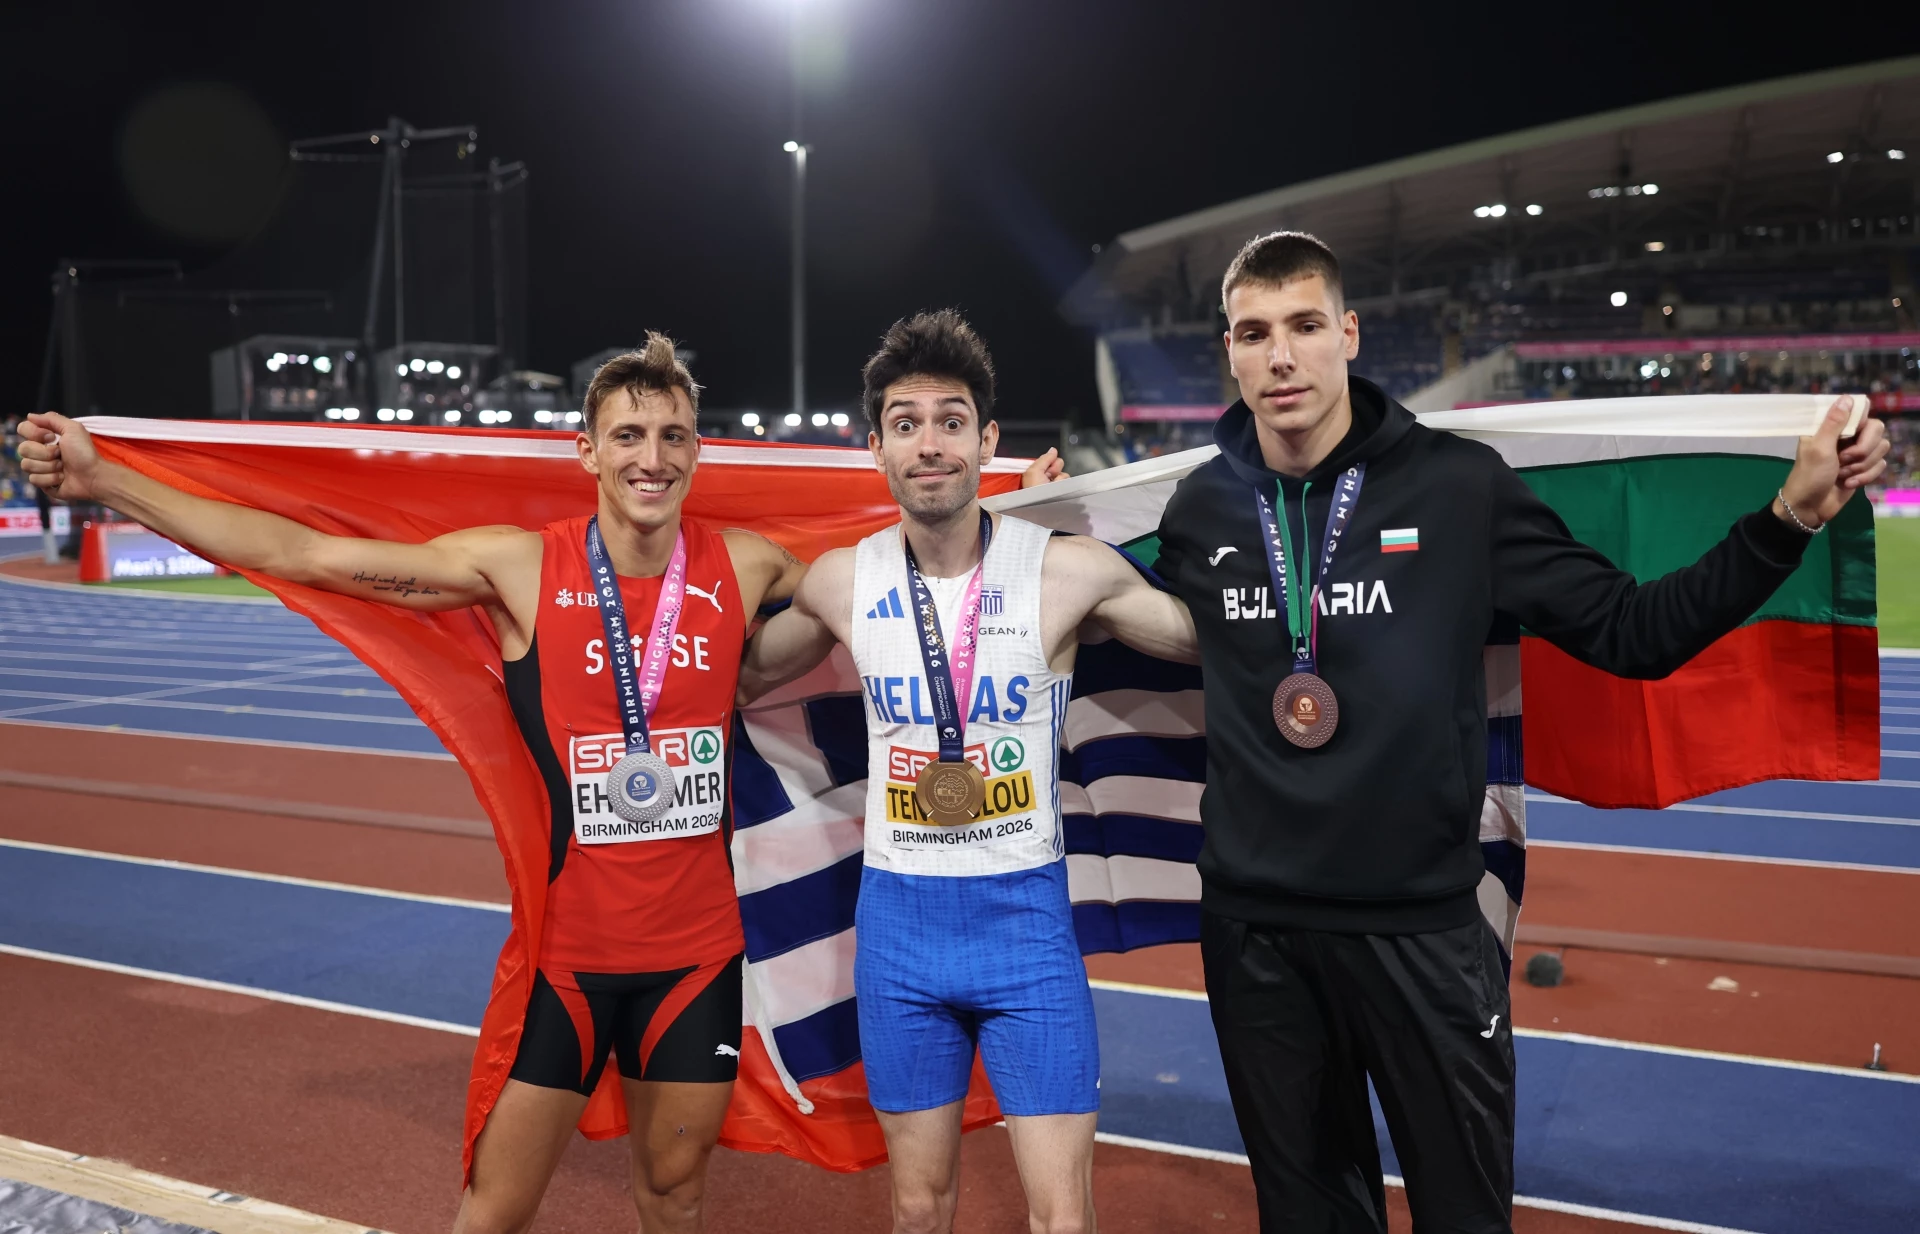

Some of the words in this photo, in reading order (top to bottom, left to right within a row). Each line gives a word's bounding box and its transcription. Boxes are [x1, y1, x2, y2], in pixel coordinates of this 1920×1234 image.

[352, 571, 378, 584] Hard
[577, 592, 599, 607] UB
[1222, 579, 1393, 620] BULARIA
[978, 626, 1016, 636] GEAN
[609, 616, 639, 725] BIRMINGHAM
[865, 675, 1030, 725] HELAS
[576, 737, 687, 769] SPR
[891, 749, 987, 778] SPR
[576, 771, 722, 814] EHMER
[887, 775, 1030, 822] TENLOU
[582, 817, 688, 837] BIRMINGHAM
[691, 812, 719, 829] 2026
[893, 827, 993, 845] BIRMINGHAM
[996, 817, 1034, 837] 2026
